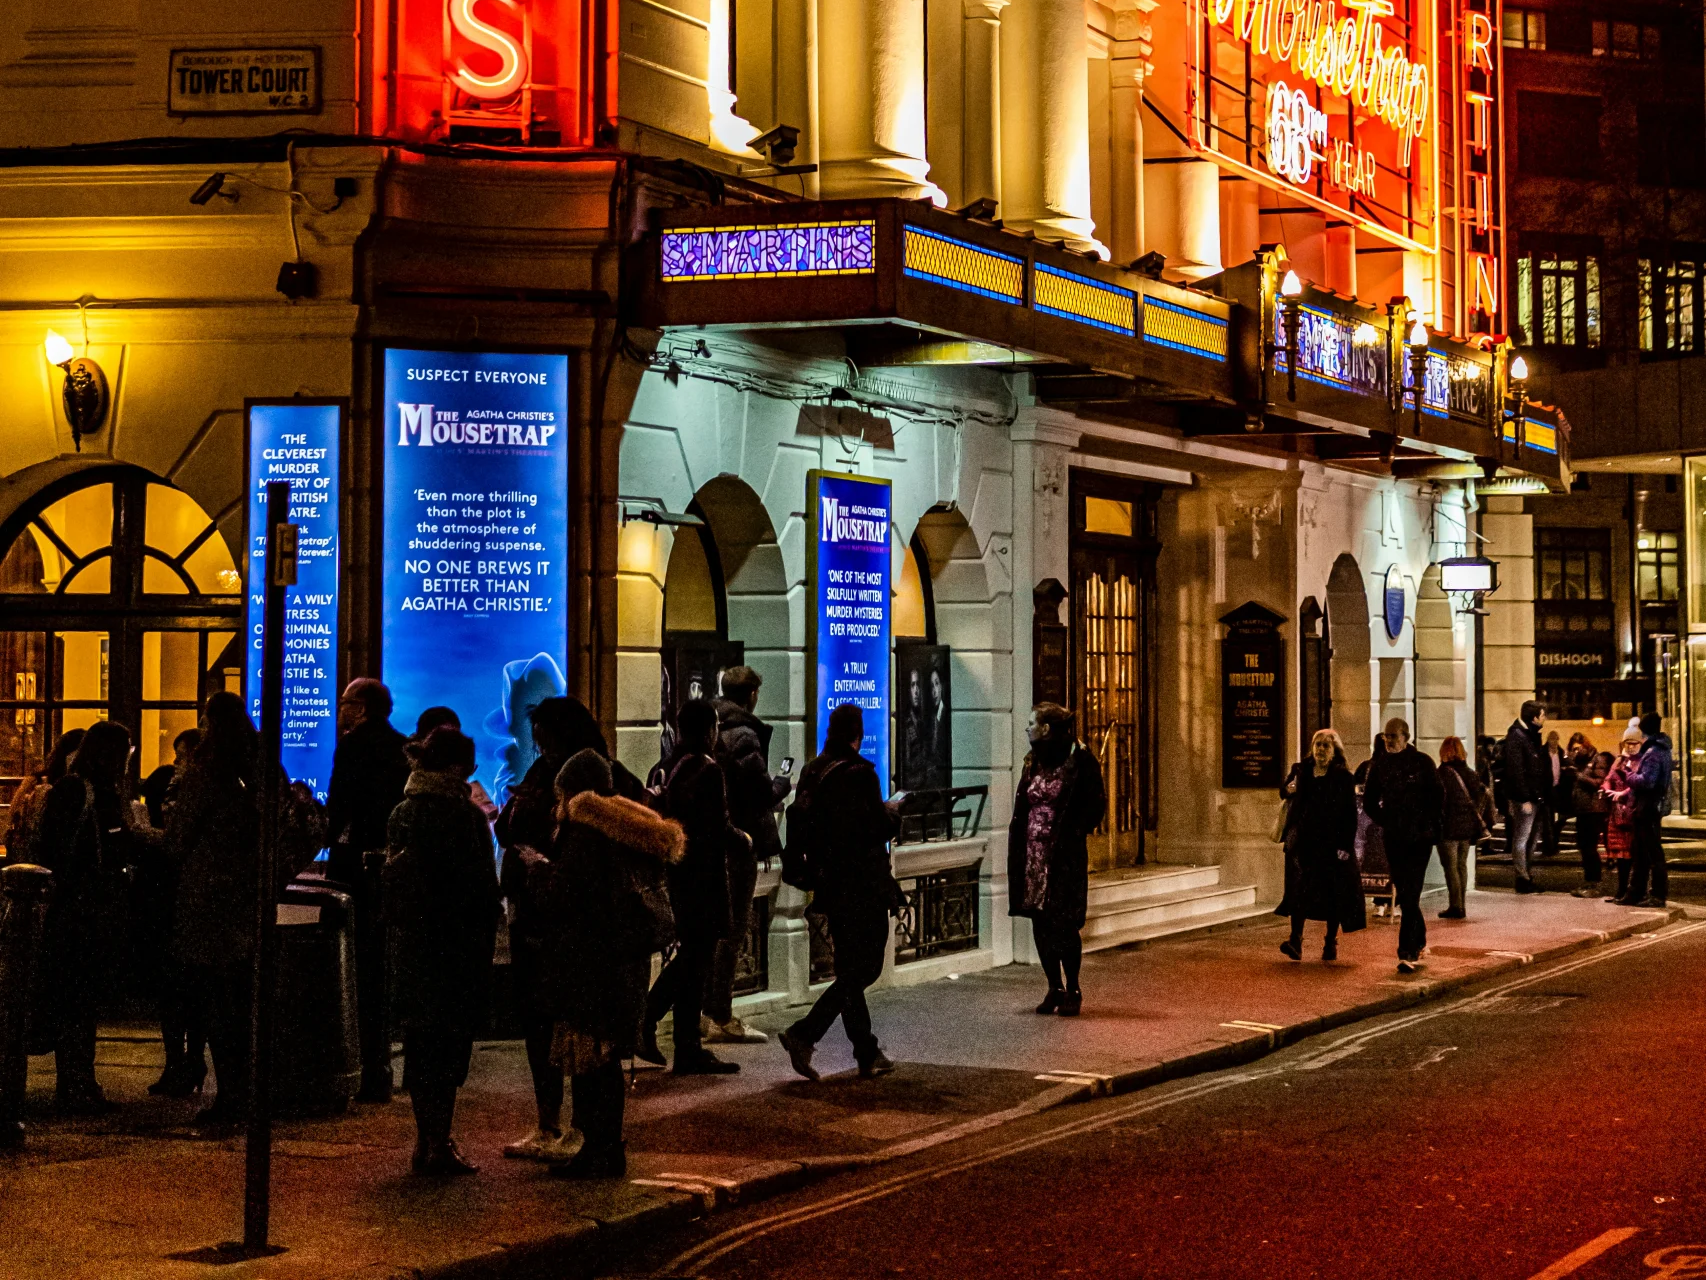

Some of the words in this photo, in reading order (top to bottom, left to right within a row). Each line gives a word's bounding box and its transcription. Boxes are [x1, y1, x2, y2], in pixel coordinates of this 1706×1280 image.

[176, 67, 243, 94] TOWER
[247, 66, 309, 93] COURT
[1332, 137, 1376, 198] YEAR
[407, 368, 469, 383] SUSPECT
[475, 371, 547, 385] EVERYONE
[436, 411, 459, 421] THE
[466, 410, 504, 419] AGATHA
[506, 411, 554, 421] CHRISTIE'S
[398, 402, 556, 446] MOUSETRAP
[281, 434, 307, 444] 'THE
[263, 448, 327, 459] CLEVEREST
[268, 463, 319, 473] MURDER
[313, 478, 330, 488] OF
[291, 492, 328, 503] RITISH
[413, 489, 447, 501] 'Even
[451, 492, 484, 502] more
[489, 491, 537, 506] thrilling
[427, 506, 457, 517] than
[461, 507, 483, 518] the
[487, 508, 511, 521] plot
[516, 508, 526, 518] is
[839, 506, 849, 517] THE
[851, 505, 867, 516] AGATHA
[822, 496, 887, 543] MOUSETRAP
[416, 522, 438, 533] the
[442, 523, 519, 537] atmosphere
[523, 524, 537, 535] of
[408, 538, 480, 553] shuddering
[485, 541, 546, 553] suspense.
[405, 560, 431, 574] NO
[436, 560, 471, 574] ONE
[477, 561, 531, 575] BREWS
[537, 561, 550, 575] IT
[828, 570, 843, 582] 'ONE
[844, 571, 853, 583] OF
[854, 571, 865, 584] THE
[866, 572, 882, 585] MOST
[423, 579, 480, 593] BETTER
[485, 580, 529, 593] THAN
[293, 595, 302, 605] A
[305, 594, 333, 605] WILY
[827, 587, 857, 601] SKILFULLY
[858, 588, 882, 602] WRITTEN
[401, 597, 468, 611] AGATHA
[473, 597, 552, 612] CHRISTIE.'
[826, 605, 852, 618] MURDER
[854, 607, 882, 620] MYSTERIES
[285, 624, 332, 634] RIMINAL
[830, 623, 845, 636] EVER
[847, 624, 880, 637] PRODUCED.'
[1244, 654, 1259, 668] THE
[1539, 653, 1602, 665] DISHOOM
[313, 669, 327, 678] IS.
[850, 662, 868, 674] TRULY
[834, 679, 875, 692] ENTERTAINING
[1229, 673, 1275, 687] MOUSETRAP
[293, 686, 310, 694] like
[292, 697, 328, 706] hostess
[1236, 700, 1267, 708] AGATHA
[289, 708, 331, 717] hemlock
[1234, 709, 1270, 717] CHRISTIE
[287, 720, 318, 728] dinner
